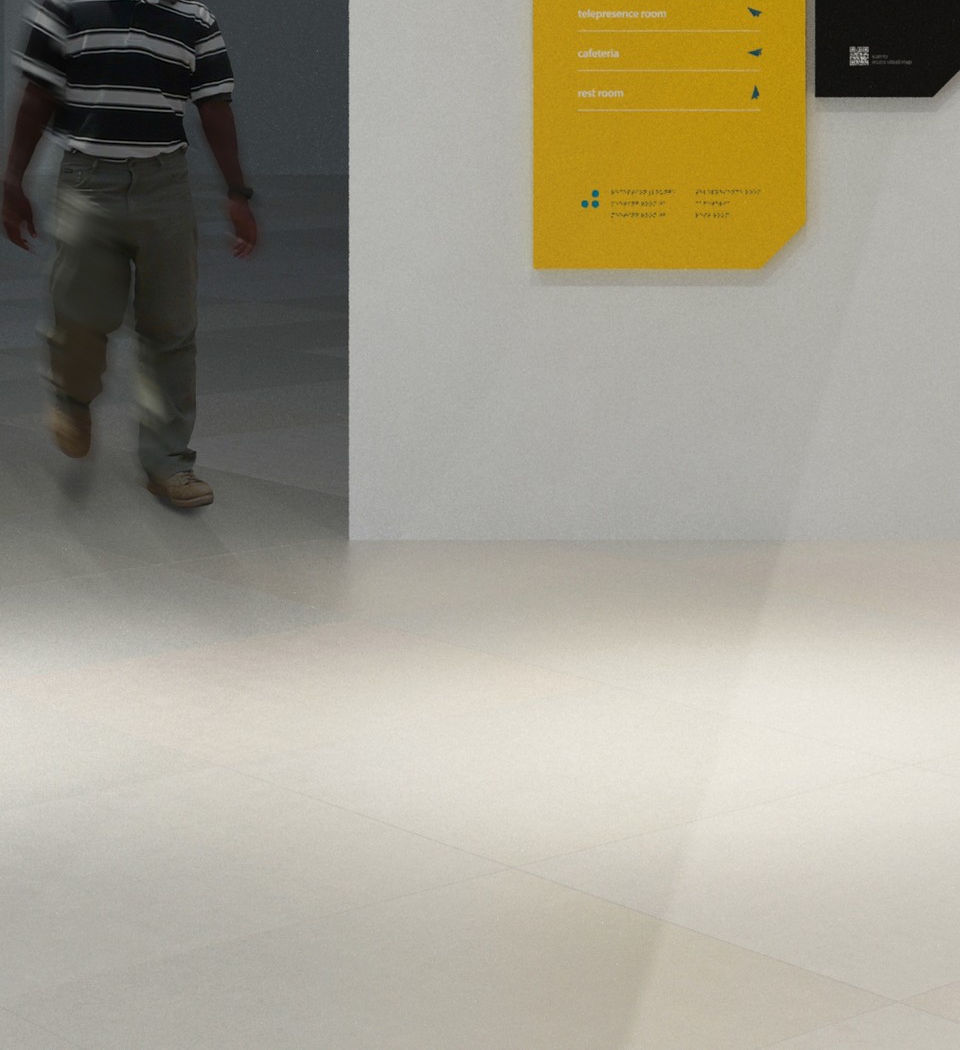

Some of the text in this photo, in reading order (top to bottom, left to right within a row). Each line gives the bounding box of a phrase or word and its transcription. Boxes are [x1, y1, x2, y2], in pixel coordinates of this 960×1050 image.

[578, 9, 667, 20] telepresence room
[578, 49, 620, 58] cafeteria
[578, 89, 596, 97] rest
